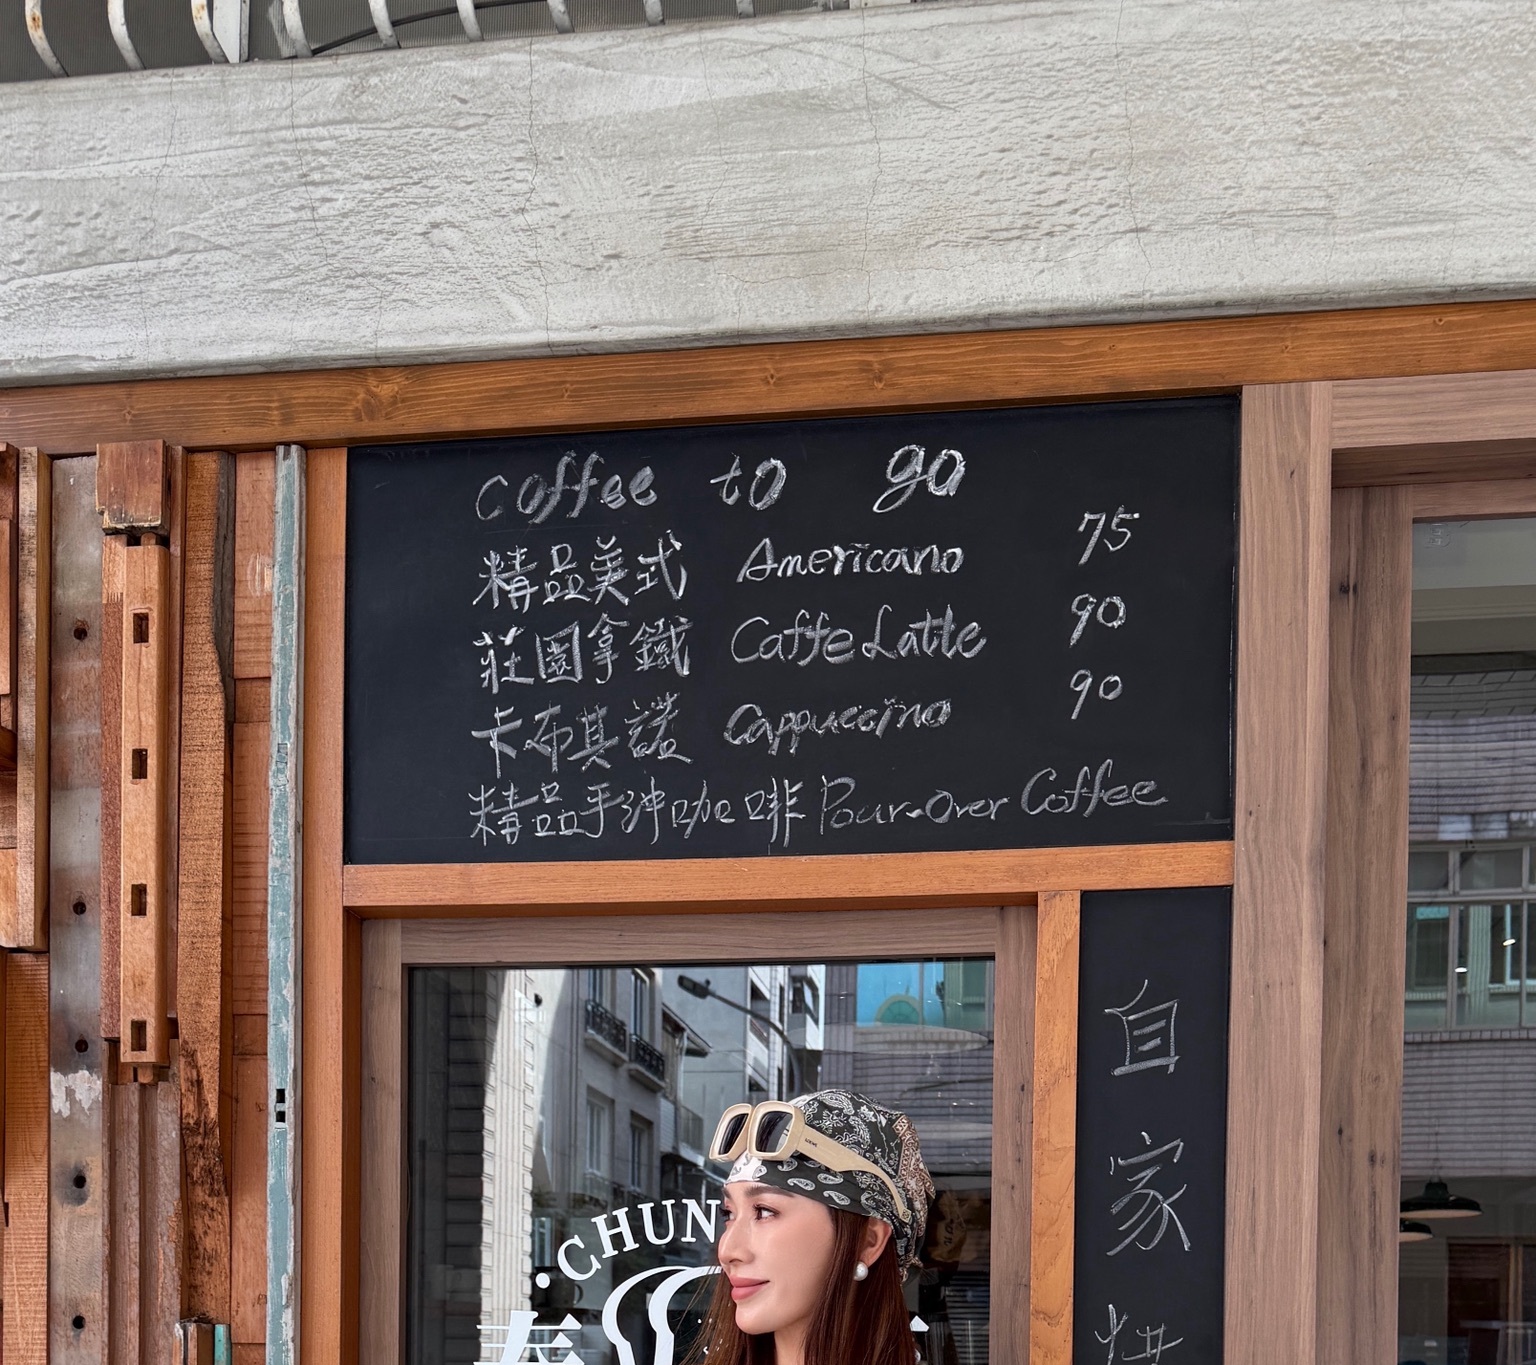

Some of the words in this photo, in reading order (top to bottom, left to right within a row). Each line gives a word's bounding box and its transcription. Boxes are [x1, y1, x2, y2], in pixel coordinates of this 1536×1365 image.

[872, 444, 967, 514] go
[472, 529, 688, 614] 精品美式
[736, 537, 964, 583] Americano
[1077, 506, 1140, 565] 75
[472, 611, 693, 695] 莊園拿鐵
[1069, 593, 1126, 646] 90
[1069, 669, 1123, 720] 90
[1020, 758, 1169, 818] Coffee
[557, 1198, 722, 1281] CHUN
